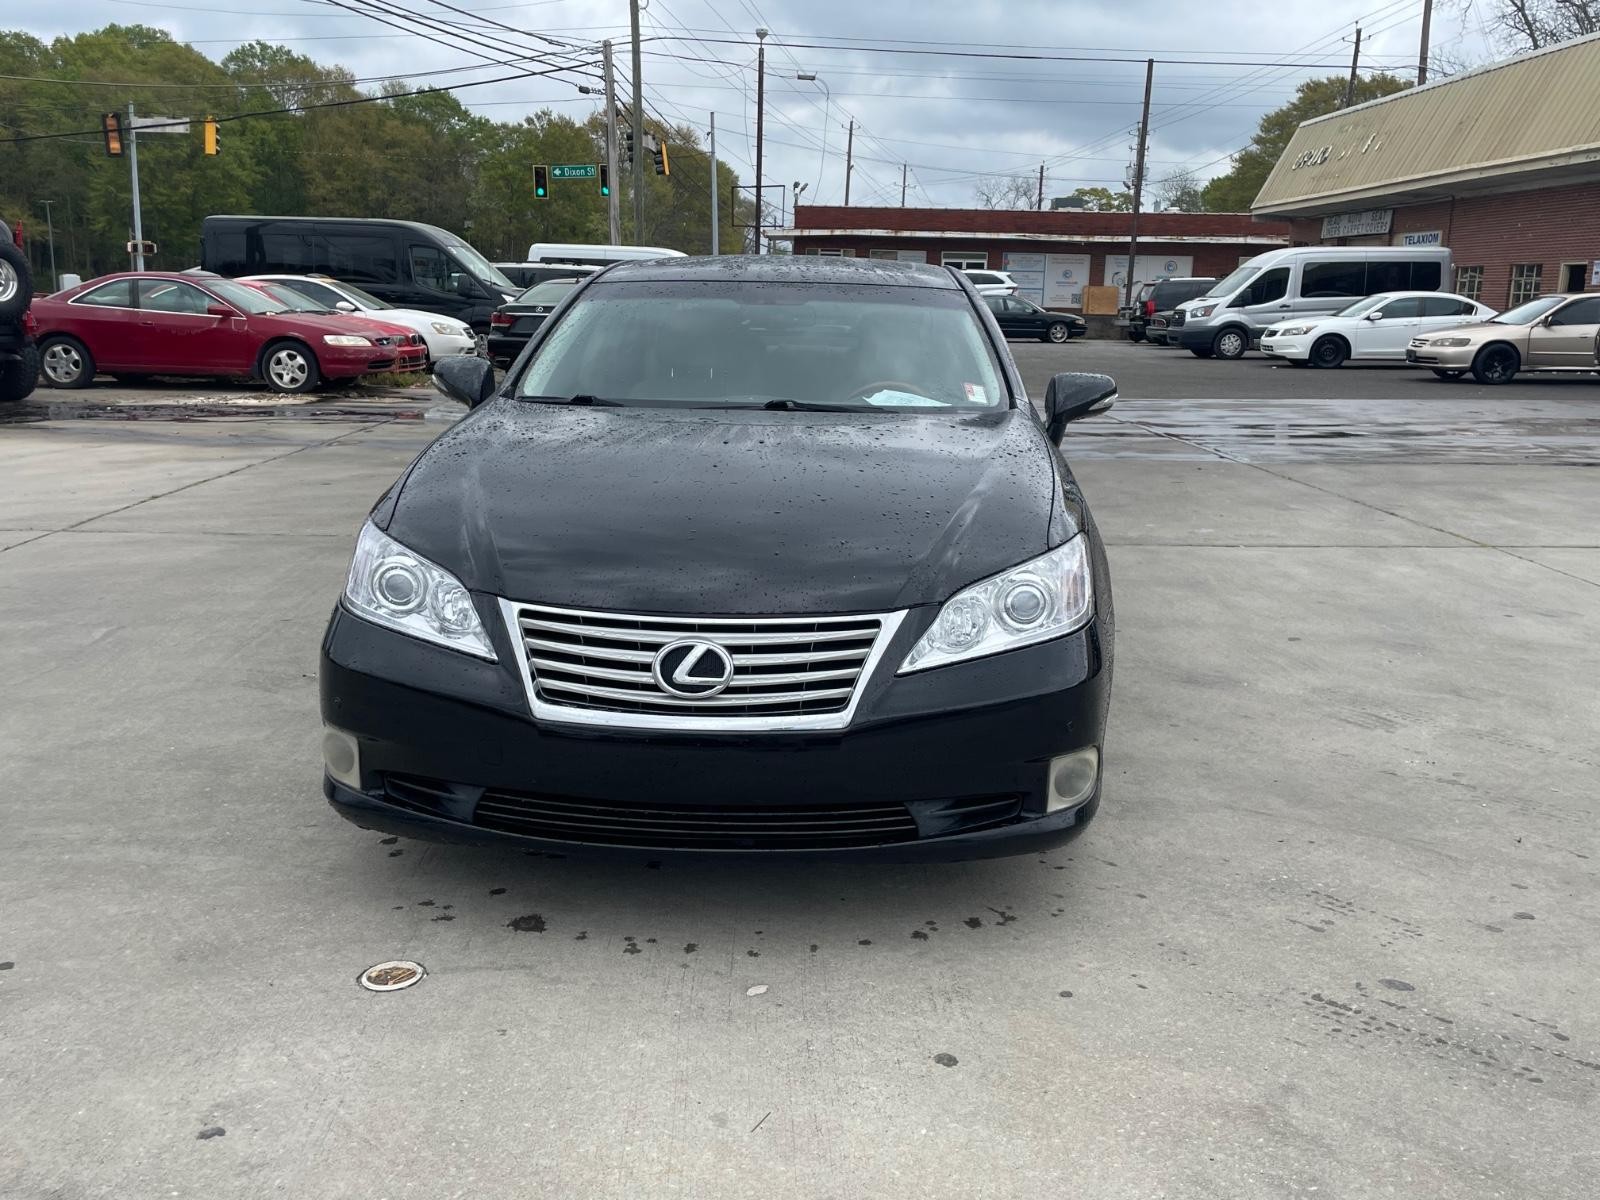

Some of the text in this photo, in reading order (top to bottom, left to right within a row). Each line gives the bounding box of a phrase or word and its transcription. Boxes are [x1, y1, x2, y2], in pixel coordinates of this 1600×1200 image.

[564, 167, 595, 176] Dixon St
[1371, 210, 1388, 221] SEAT
[1365, 221, 1388, 233] COVERS
[1404, 233, 1439, 245] TELAXIOM
